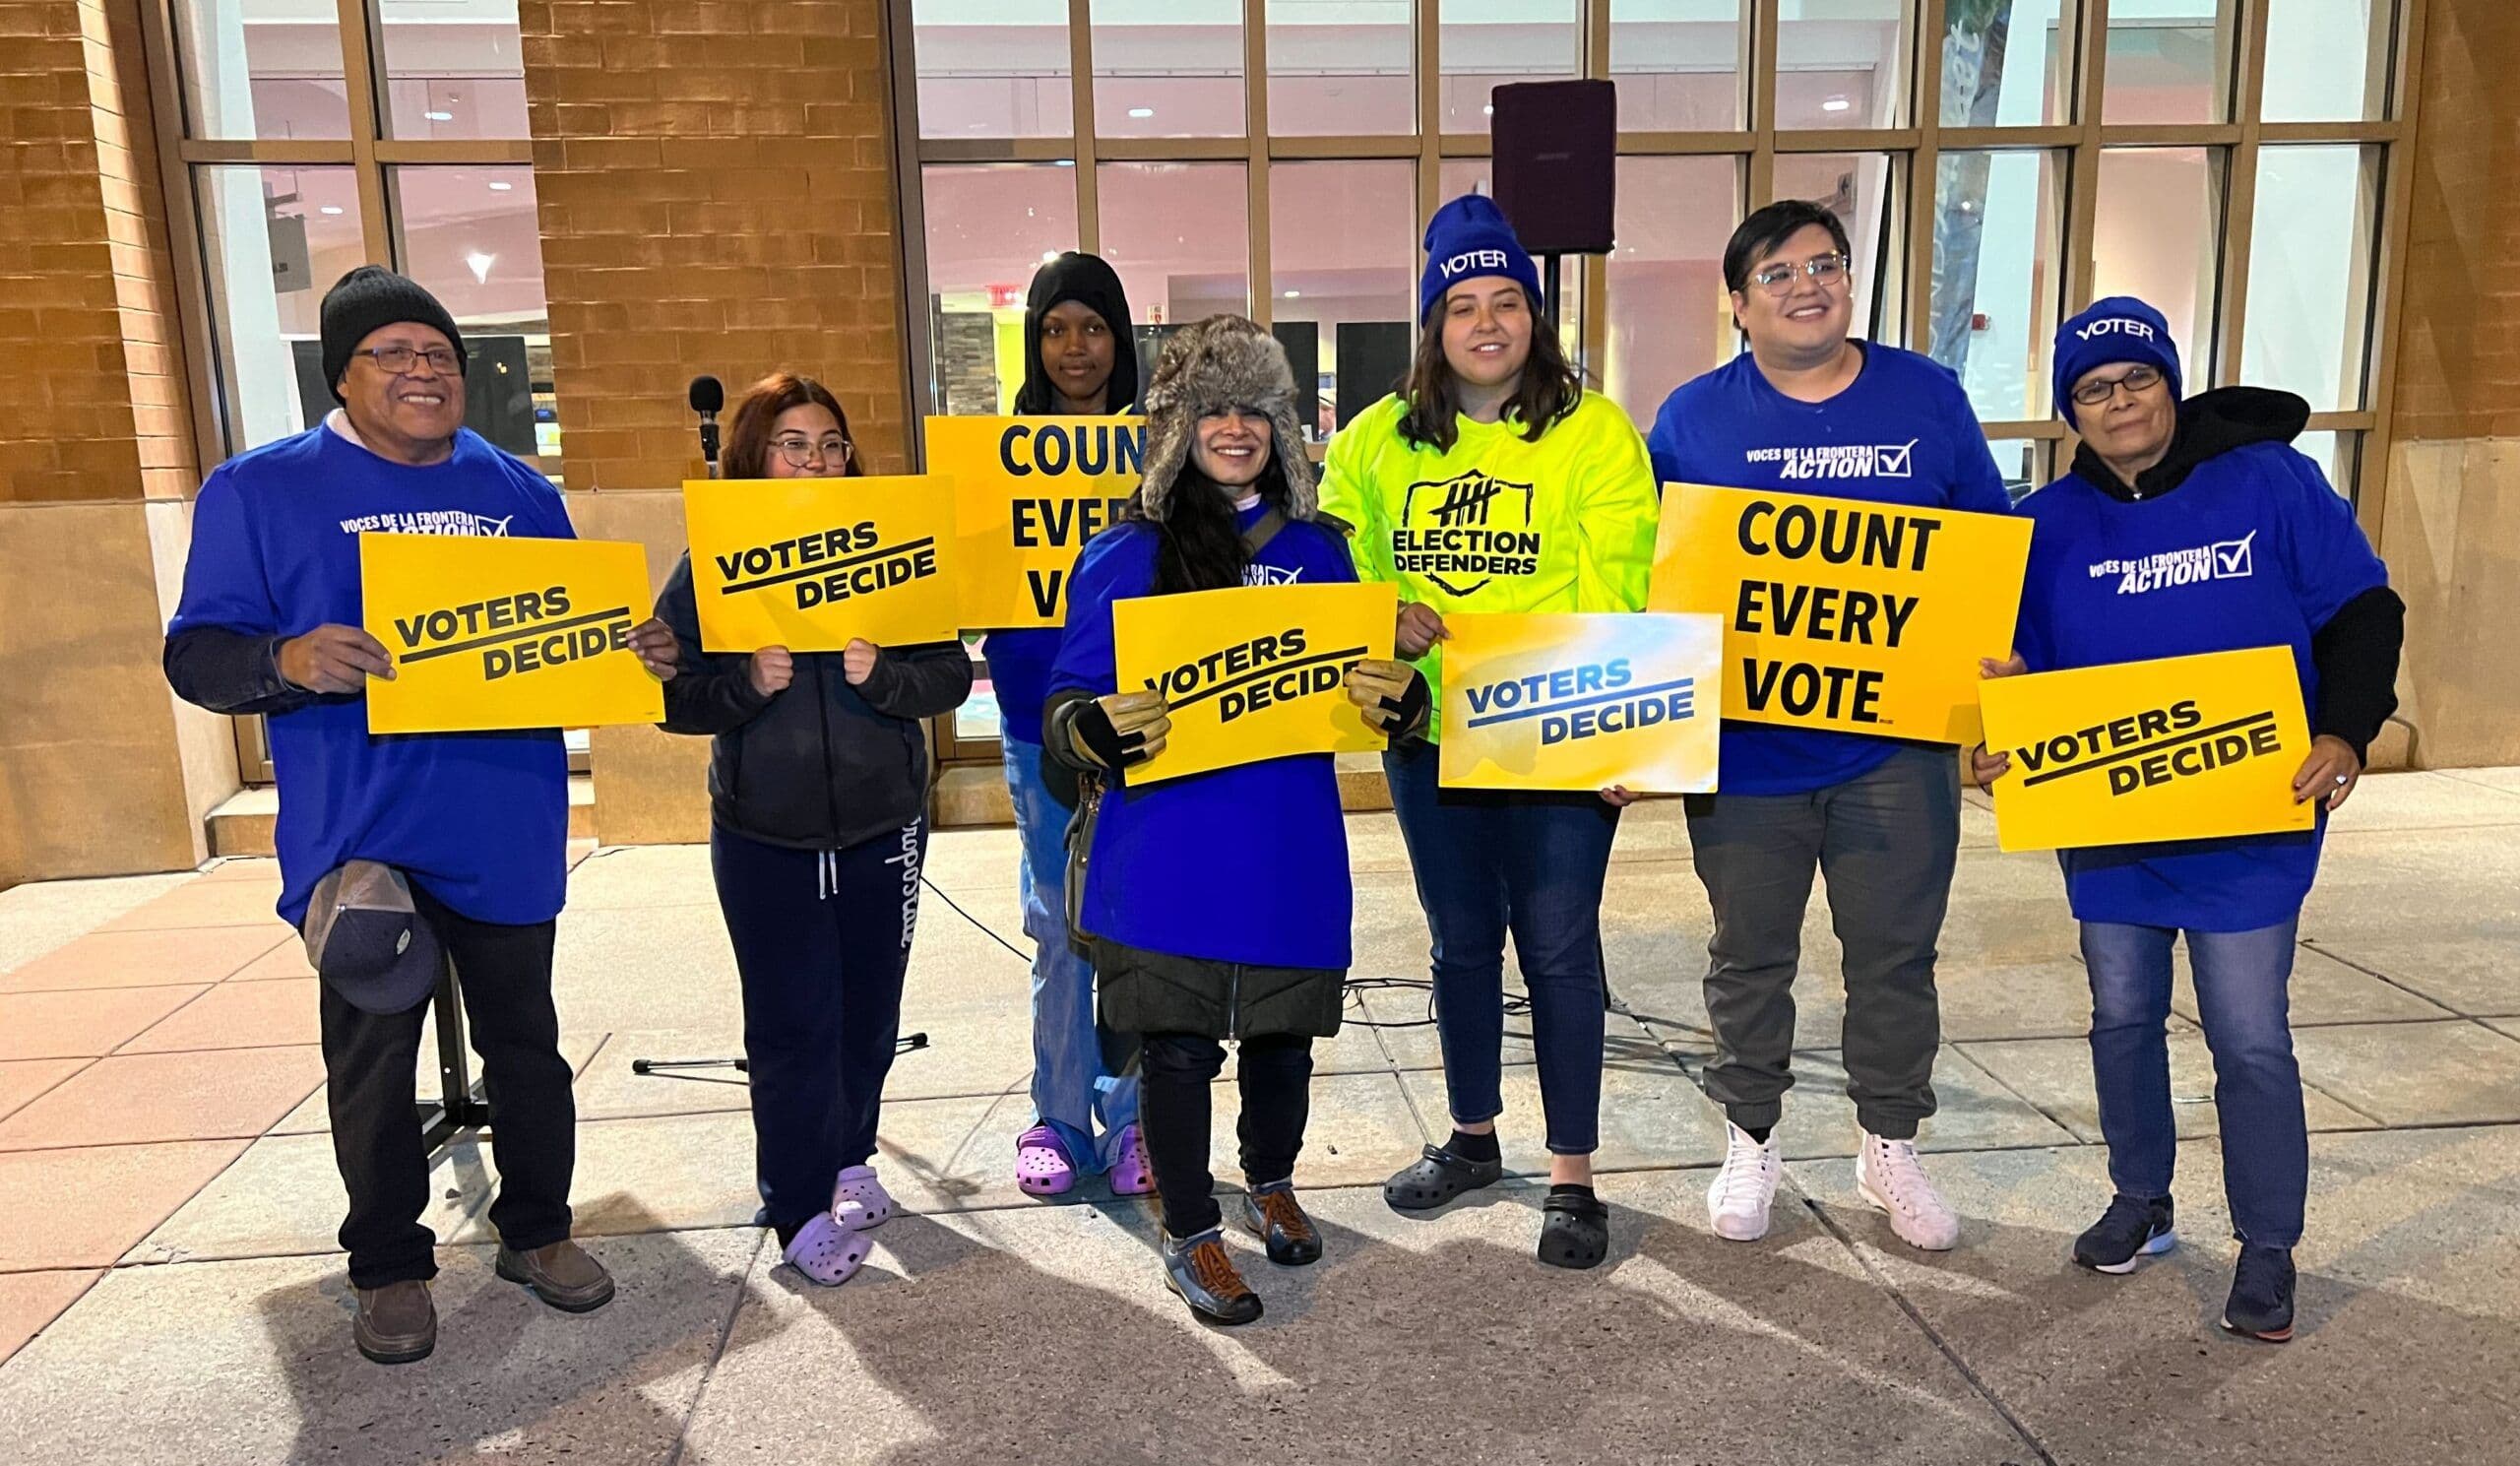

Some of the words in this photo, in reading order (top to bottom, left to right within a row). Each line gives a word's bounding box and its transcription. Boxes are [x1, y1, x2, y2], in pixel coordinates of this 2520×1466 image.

[1440, 249, 1507, 280] VOTER
[2075, 317, 2154, 343] VOTER
[999, 424, 1148, 477] COUN
[1746, 448, 1781, 463] VOCES
[1783, 448, 1797, 460] DE
[1800, 447, 1815, 460] LA
[1816, 445, 1874, 460] FRONTERA
[1779, 457, 1874, 479] ACTION
[340, 515, 380, 534] VOCES
[381, 514, 399, 528] DE
[399, 512, 415, 528] LA
[417, 510, 474, 528] FRONTERA
[1012, 498, 1127, 547] EVE
[1392, 529, 1541, 555] ELECTION
[1737, 500, 1942, 572] COUNT
[715, 521, 879, 581] VOTERS
[795, 547, 937, 610] DECIDE
[1394, 553, 1538, 576] DEFENDERS
[2116, 557, 2212, 595] ACTION
[2121, 560, 2137, 574] DE
[2138, 556, 2151, 572] LA
[2151, 545, 2211, 568] FRONTERA
[394, 586, 571, 648] VOTERS
[1734, 579, 1920, 648] EVERY
[482, 619, 632, 681] DECIDE
[1144, 628, 1306, 700] VOTERS
[1466, 658, 1632, 715] VOTERS
[1742, 657, 1884, 724] VOTE
[1542, 690, 1694, 745] DECIDE
[2016, 700, 2202, 772] VOTERS
[2108, 723, 2282, 797] DECIDE
